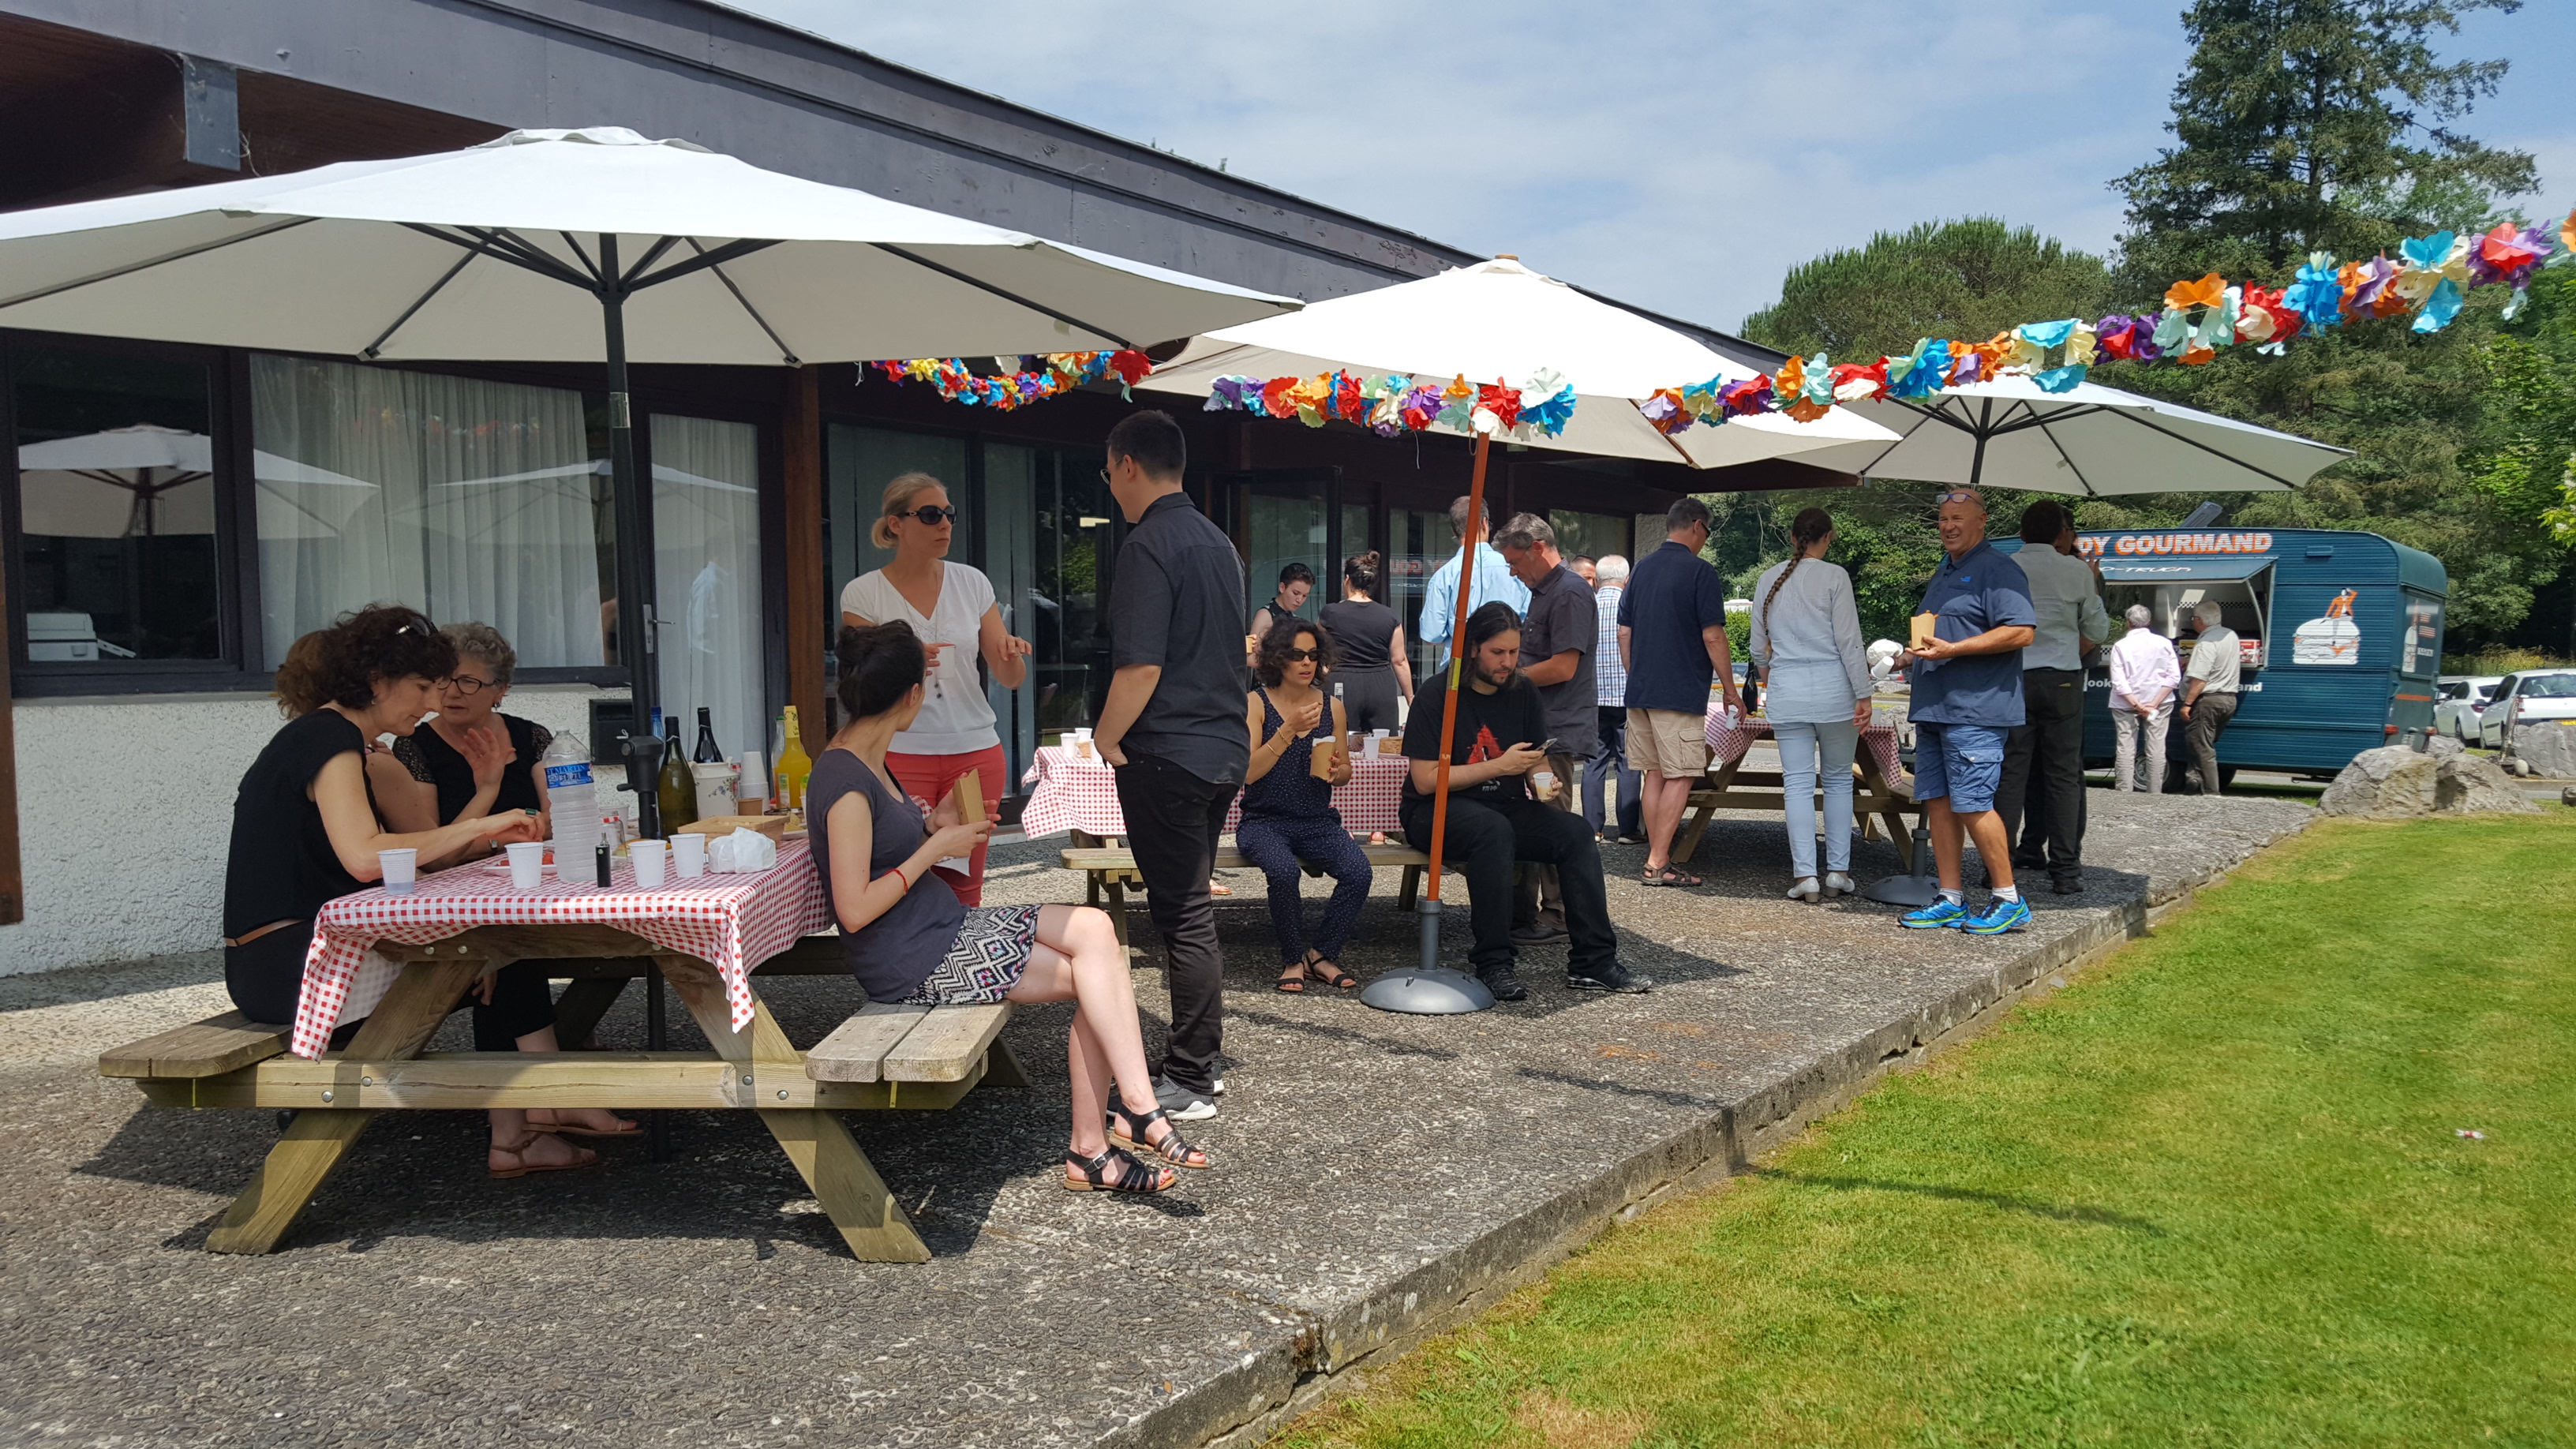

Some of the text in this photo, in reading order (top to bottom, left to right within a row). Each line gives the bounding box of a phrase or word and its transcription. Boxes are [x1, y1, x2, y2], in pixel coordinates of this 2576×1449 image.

[2077, 533, 2273, 555] DY GOURMAND
[2087, 678, 2263, 692] ook and
[554, 764, 586, 775] MARTIN
